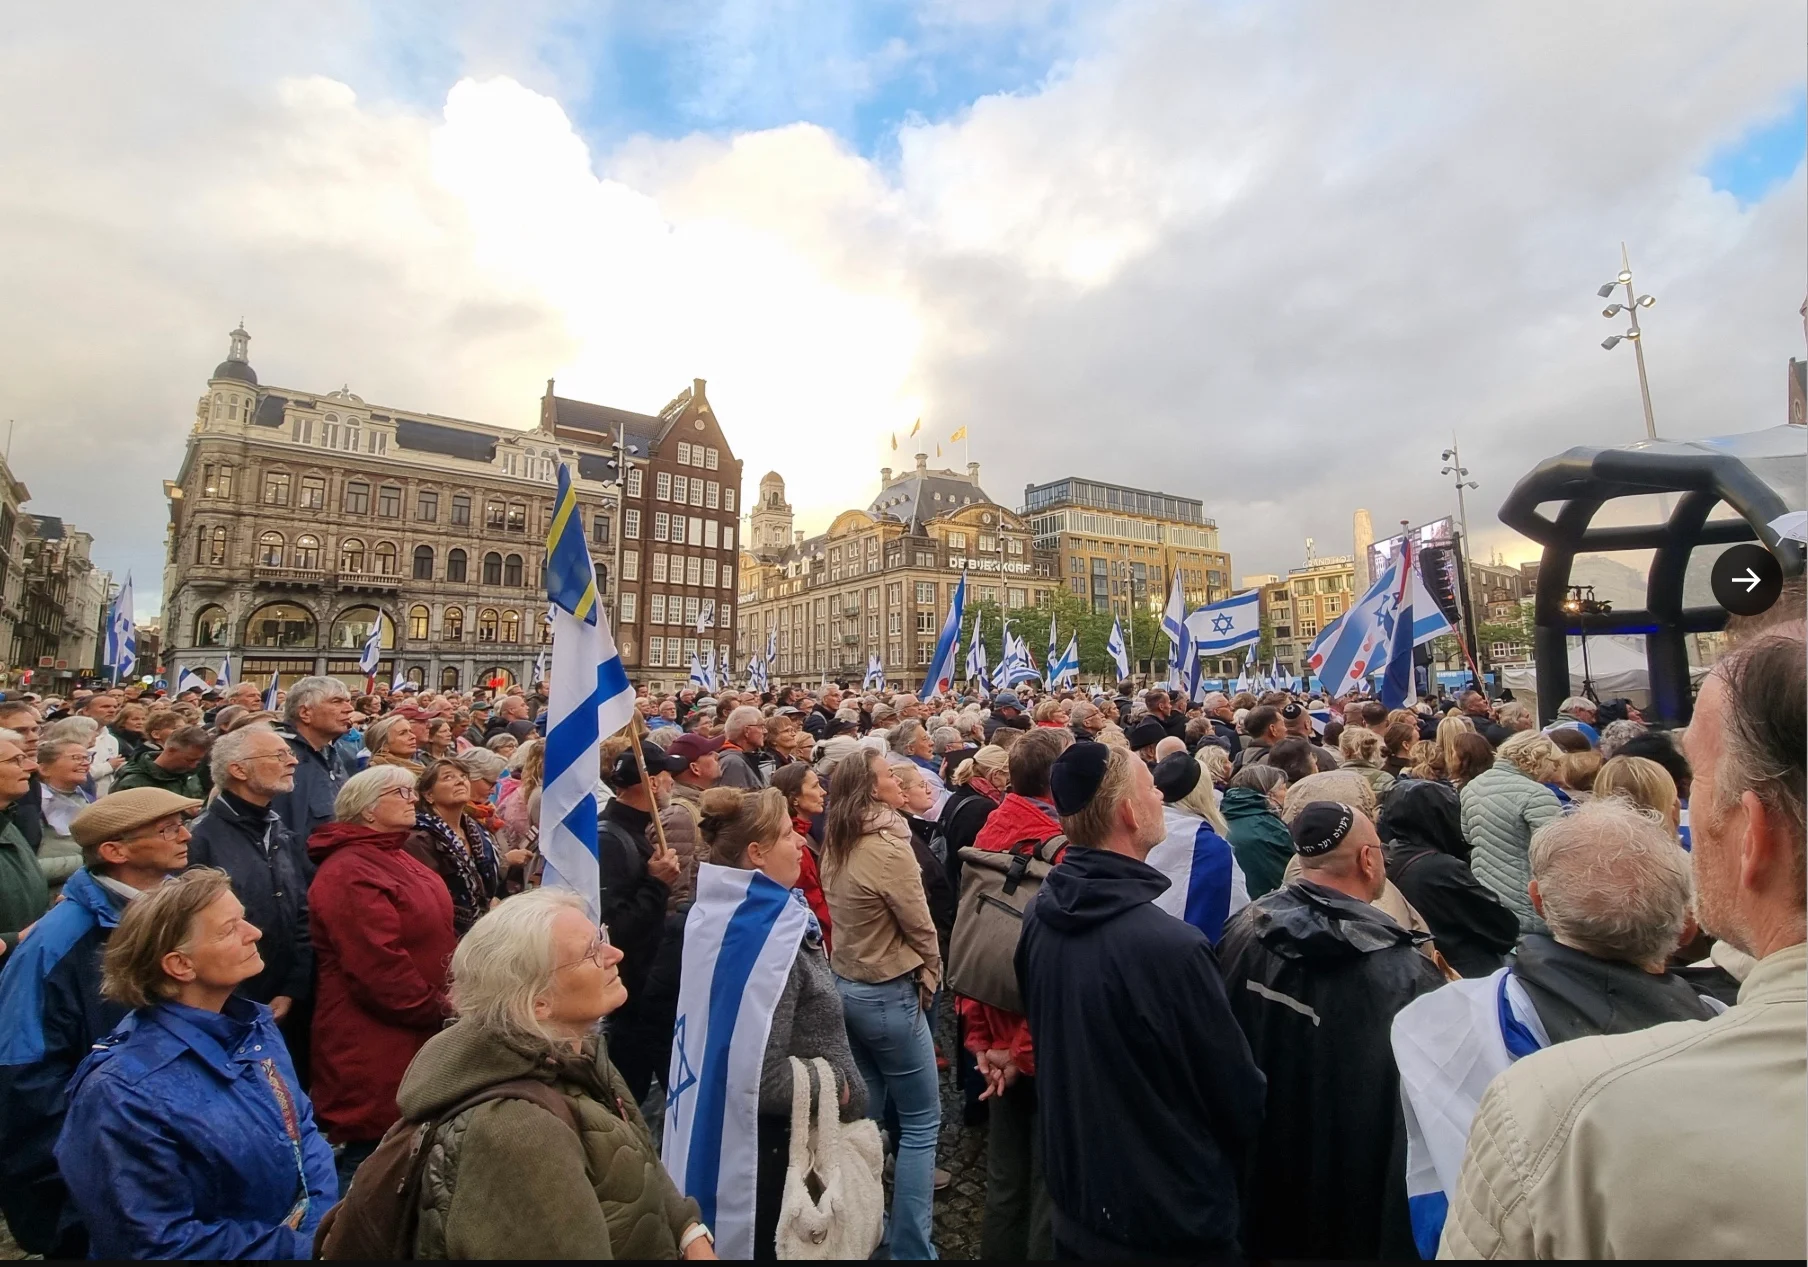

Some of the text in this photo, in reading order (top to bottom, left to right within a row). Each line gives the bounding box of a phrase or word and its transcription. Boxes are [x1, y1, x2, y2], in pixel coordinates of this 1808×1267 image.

[949, 556, 1031, 574] DE BIJENKORF
[1302, 558, 1330, 568] GRAND
[1332, 816, 1350, 838] לעולם
